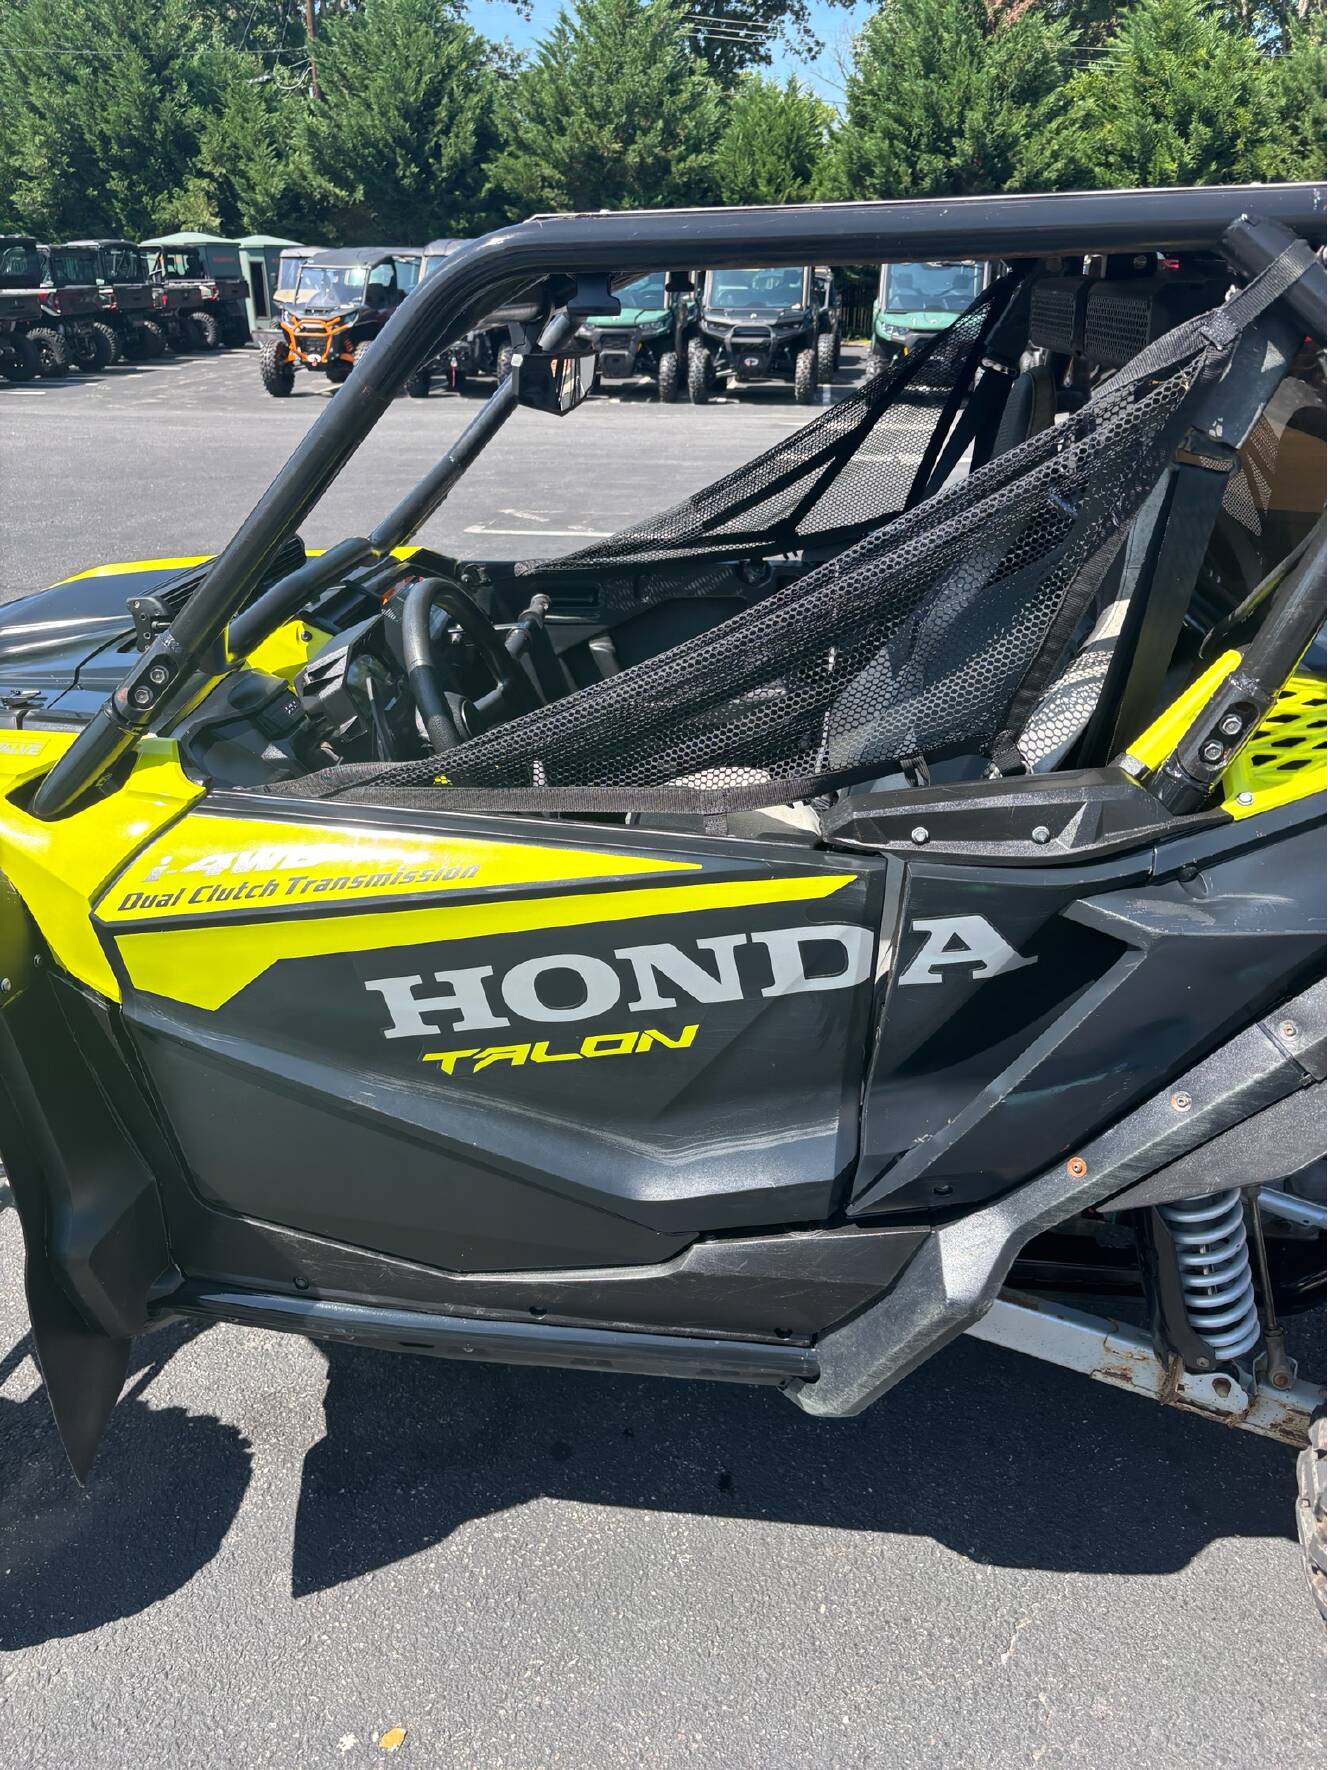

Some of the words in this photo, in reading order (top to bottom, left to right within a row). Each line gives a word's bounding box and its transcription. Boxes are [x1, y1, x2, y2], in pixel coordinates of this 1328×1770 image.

[117, 888, 186, 912] Dual
[188, 875, 279, 905] Clutch
[285, 863, 481, 896] Transmission
[364, 913, 1039, 1040] HONDA
[422, 1024, 700, 1076] TALON
